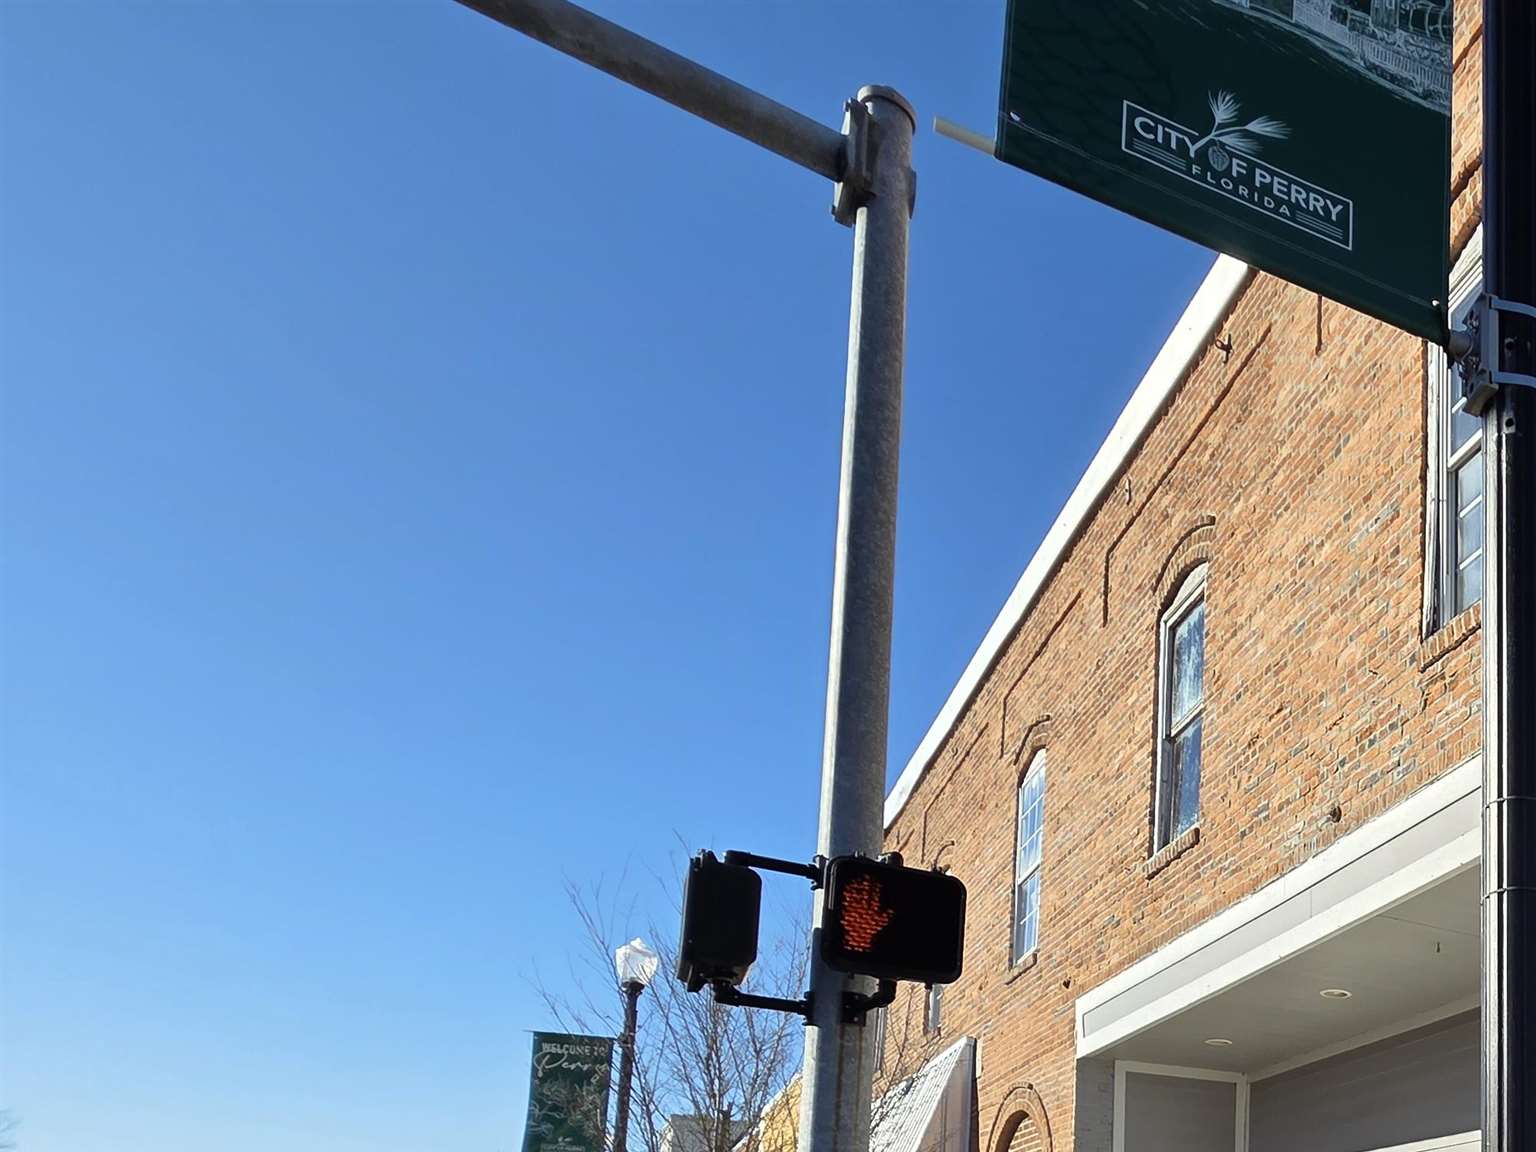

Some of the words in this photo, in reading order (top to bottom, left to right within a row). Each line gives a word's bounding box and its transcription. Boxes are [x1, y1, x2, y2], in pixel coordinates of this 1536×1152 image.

[1134, 116, 1201, 158] CITY
[1254, 168, 1344, 222] PERRY
[1191, 164, 1292, 217] FLORIDA
[542, 1042, 591, 1056] WELCOME
